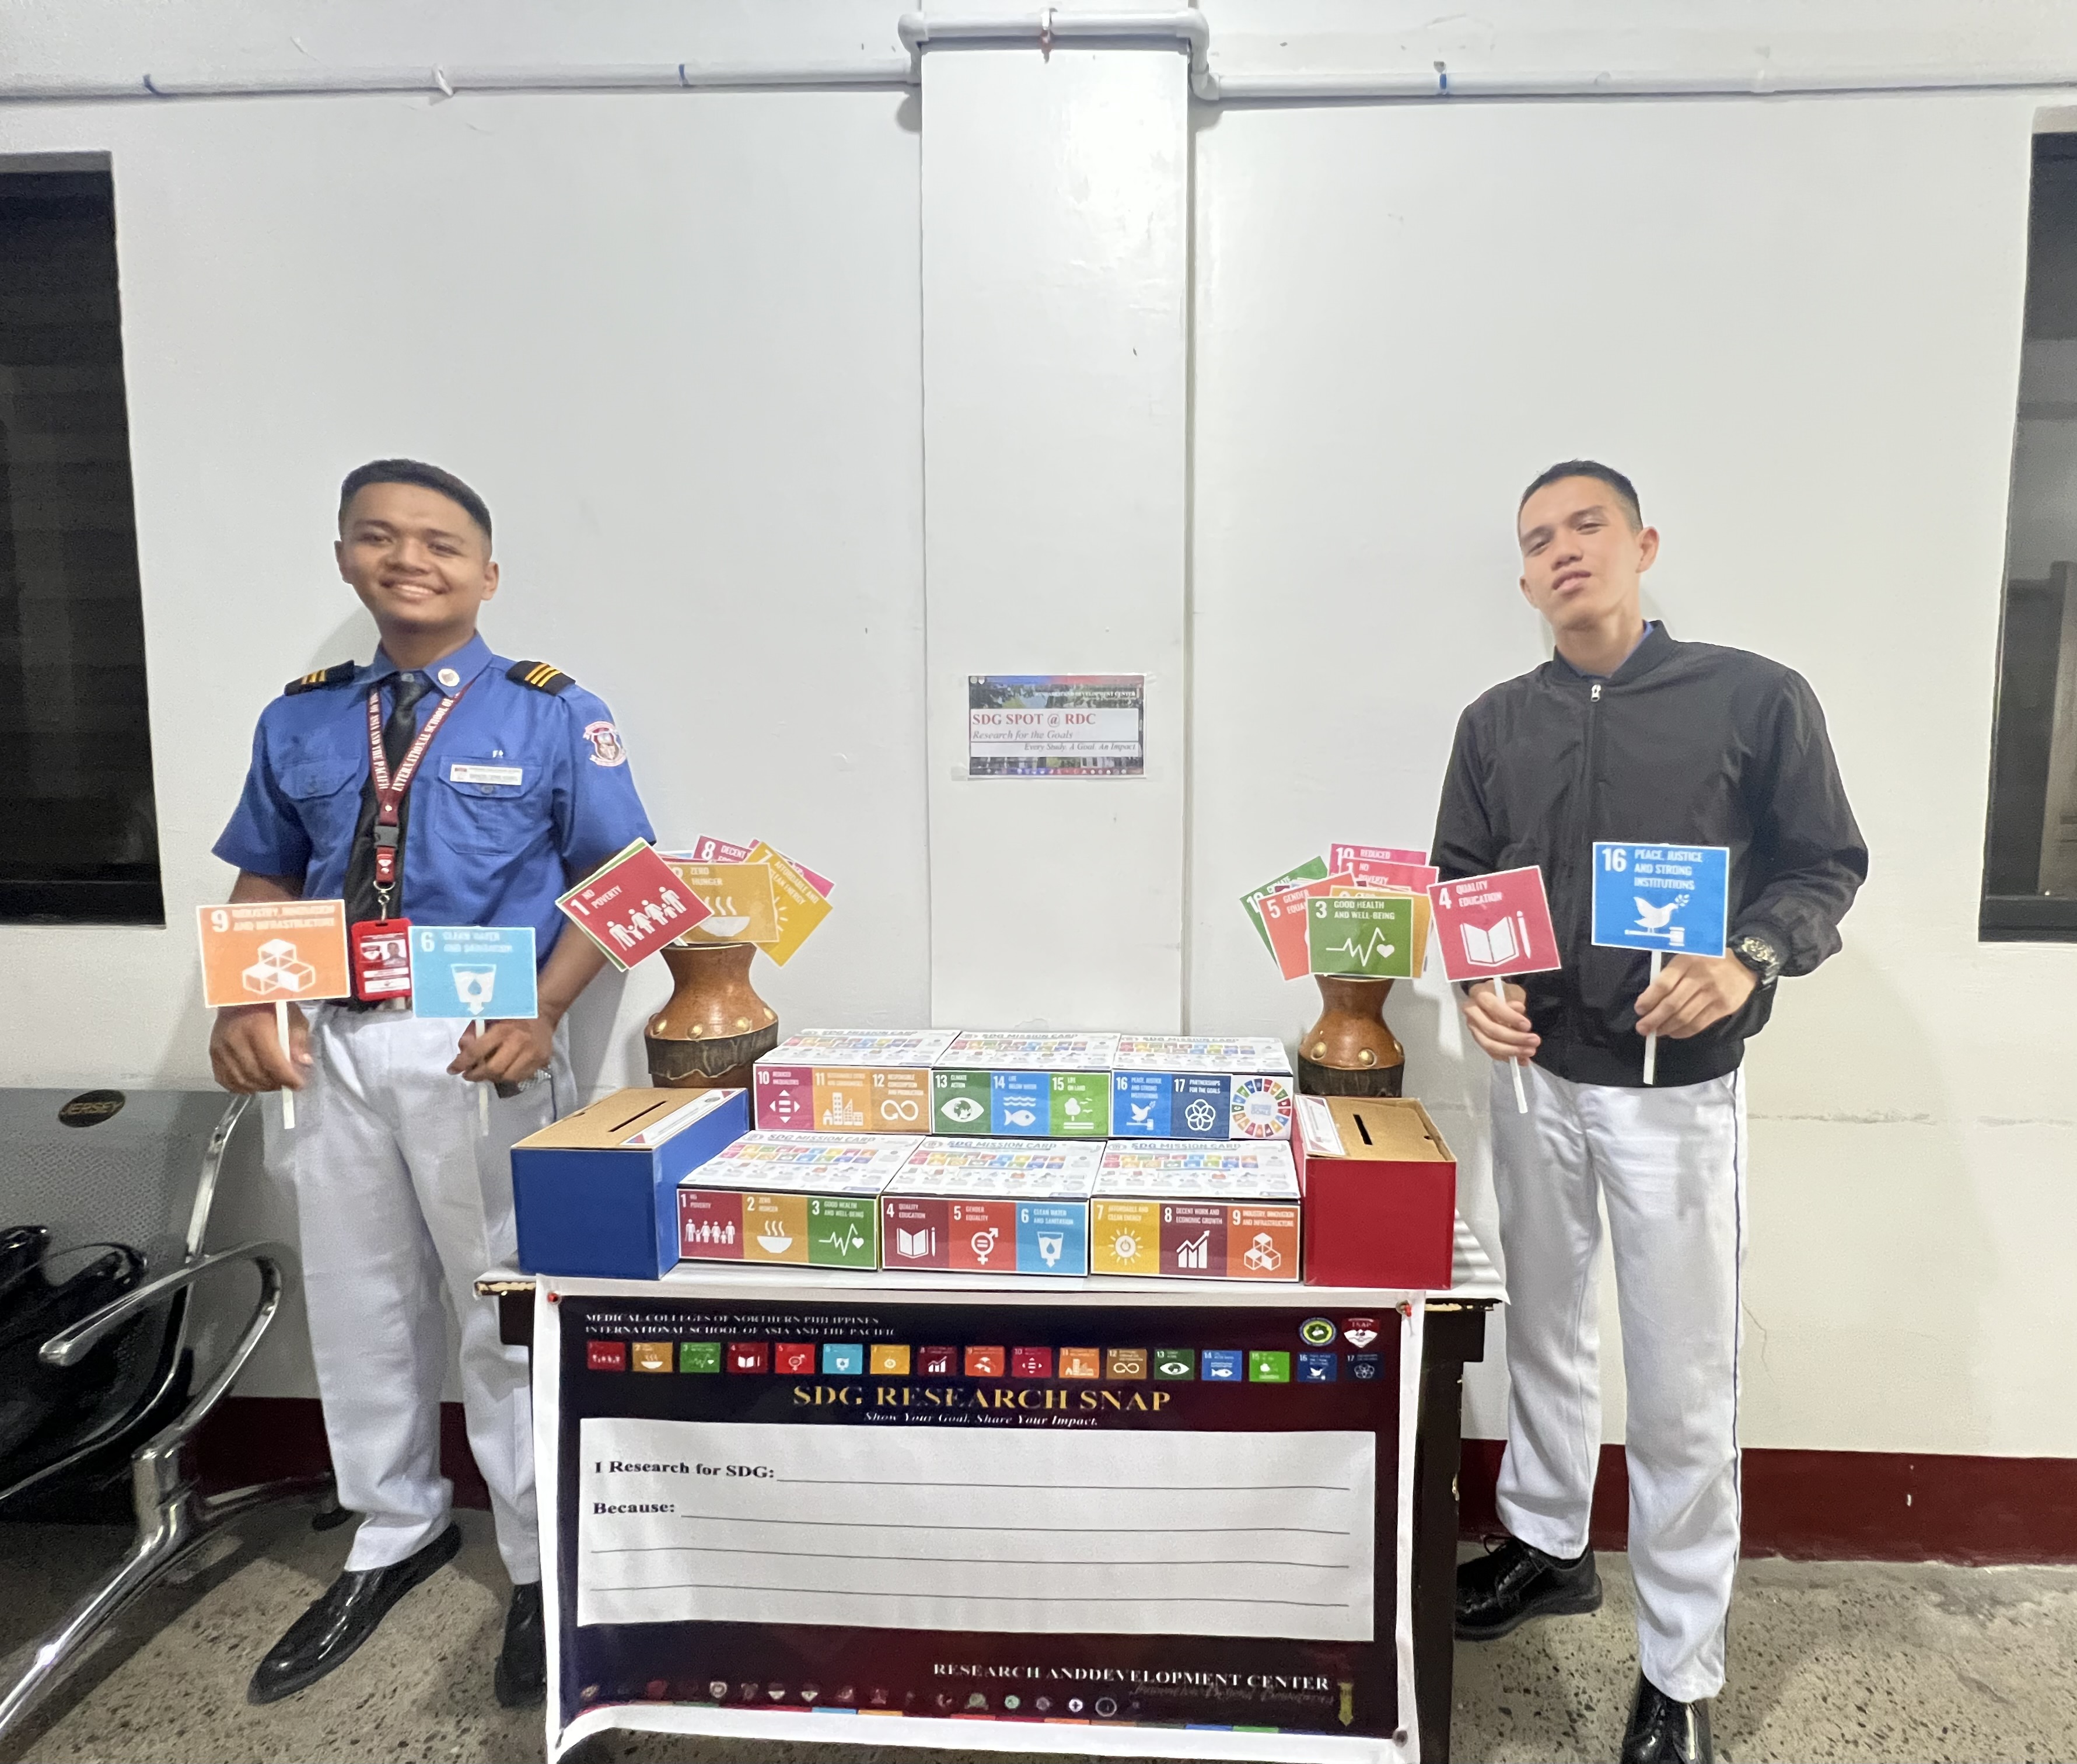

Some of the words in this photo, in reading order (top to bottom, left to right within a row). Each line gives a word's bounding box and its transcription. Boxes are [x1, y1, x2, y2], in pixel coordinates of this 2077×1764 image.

[973, 714, 1002, 725] SDG
[1006, 713, 1043, 725] SPOT
[1047, 713, 1060, 727] @
[1065, 713, 1096, 725] RDC
[973, 730, 1013, 739] Research
[1015, 730, 1029, 740] for
[1030, 730, 1044, 739] the
[1047, 730, 1074, 739] Goals
[391, 733, 431, 792] INTERNATIONAL
[424, 708, 449, 733] SCHOOL
[1024, 743, 1044, 752] Every
[701, 841, 716, 860] 8
[721, 845, 746, 859] DECENT
[1360, 849, 1390, 860] REDUCED
[1359, 863, 1369, 871] NO
[1602, 848, 1627, 872] 16
[1667, 851, 1703, 862] JUSTICE
[690, 867, 709, 875] ZERO
[1634, 864, 1653, 874] AND
[1655, 864, 1692, 876] STRONG
[774, 861, 809, 893] AFFORDABLE
[806, 890, 820, 904] AND
[1634, 877, 1695, 890] INSTITUTIONS
[591, 885, 623, 909] POVERTY
[1439, 888, 1452, 909] 4
[1456, 879, 1488, 895] QUALITY
[1459, 892, 1502, 907] EDUCATION
[570, 899, 590, 916] 1
[581, 889, 595, 900] NO
[1267, 899, 1281, 918] 5
[1283, 889, 1310, 903] GENDER
[1316, 901, 1327, 918] 3
[211, 910, 229, 932] 9
[421, 932, 435, 952] 6
[758, 1071, 770, 1085] 10
[815, 1073, 826, 1086] 11
[872, 1074, 885, 1087] 12
[935, 1074, 947, 1088] 13
[993, 1075, 1005, 1089] 14
[1052, 1077, 1064, 1091] 15
[1116, 1077, 1128, 1091] 16
[1174, 1078, 1186, 1092] 17
[680, 1193, 687, 1207] 1
[747, 1197, 756, 1211] 2
[812, 1200, 820, 1215] 3
[886, 1203, 895, 1218] 4
[953, 1206, 961, 1221] 5
[1096, 1204, 1104, 1220] 7
[1021, 1208, 1029, 1223] 6
[1164, 1207, 1172, 1223] 8
[1176, 1216, 1201, 1224] ECONOMIC
[1232, 1210, 1241, 1225] 9
[585, 1314, 641, 1322] MEDICAL
[804, 1316, 879, 1324] PHILIPPINES
[793, 1386, 862, 1405] SDG
[876, 1386, 1068, 1409] RESEARCH
[1079, 1390, 1170, 1411] SNAP
[864, 1412, 897, 1422] Show
[904, 1412, 933, 1423] Your
[975, 1414, 1013, 1424] Share
[1019, 1414, 1048, 1425] Your
[595, 1462, 602, 1473] I
[609, 1461, 690, 1474] Research
[696, 1463, 722, 1475] for
[726, 1465, 775, 1479] SDG:
[593, 1502, 676, 1515] Because:
[934, 1664, 1040, 1678] RESEARCH
[1247, 1674, 1328, 1690] CENTER
